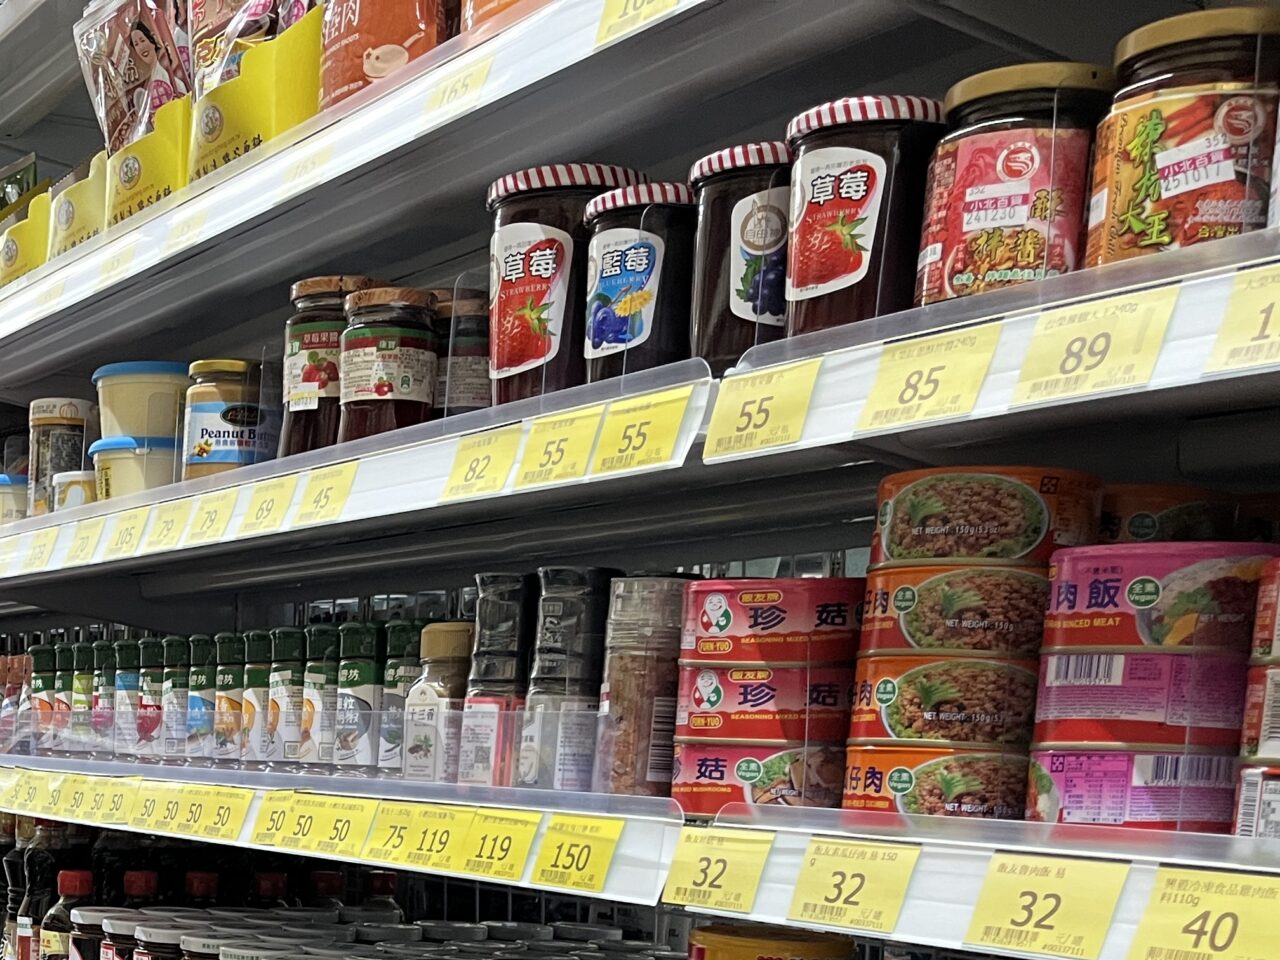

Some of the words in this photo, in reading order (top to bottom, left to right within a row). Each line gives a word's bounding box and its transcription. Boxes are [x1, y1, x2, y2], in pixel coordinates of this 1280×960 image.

[1163, 152, 1225, 179] 小北百貨
[810, 170, 869, 205] 草莓
[504, 247, 558, 281] 草莓
[601, 246, 650, 278] 藍莓
[1252, 302, 1280, 342] 1
[1058, 331, 1112, 375] 89
[898, 365, 946, 404] 85
[735, 396, 771, 433] 55
[200, 428, 244, 441] Peanut
[620, 421, 652, 453] 55
[537, 437, 569, 469] 55
[463, 455, 492, 482] 82
[255, 497, 275, 520] 69
[1130, 593, 1157, 602] Vegan
[748, 603, 848, 630] 珍菇
[961, 620, 989, 629] WEIGHT
[1093, 616, 1121, 626] MEAT
[923, 711, 937, 720] NET
[939, 713, 966, 721] WEIGHT
[696, 757, 727, 780] 菇
[889, 781, 911, 789] Vegan
[141, 799, 156, 818] 50
[163, 801, 179, 820] 50
[186, 803, 202, 824] 50
[213, 806, 231, 827] 50
[944, 803, 960, 812] NET
[961, 804, 989, 813] WEIGHT
[267, 811, 285, 832] 50
[292, 815, 313, 836] 50
[329, 818, 350, 842] 50
[382, 825, 407, 849] 75
[417, 829, 450, 853] 119
[475, 835, 512, 861] 119
[550, 844, 591, 872] 150
[693, 857, 727, 889] 32
[824, 871, 866, 906] 32
[1010, 890, 1061, 930] 32
[1182, 910, 1239, 952] 40
